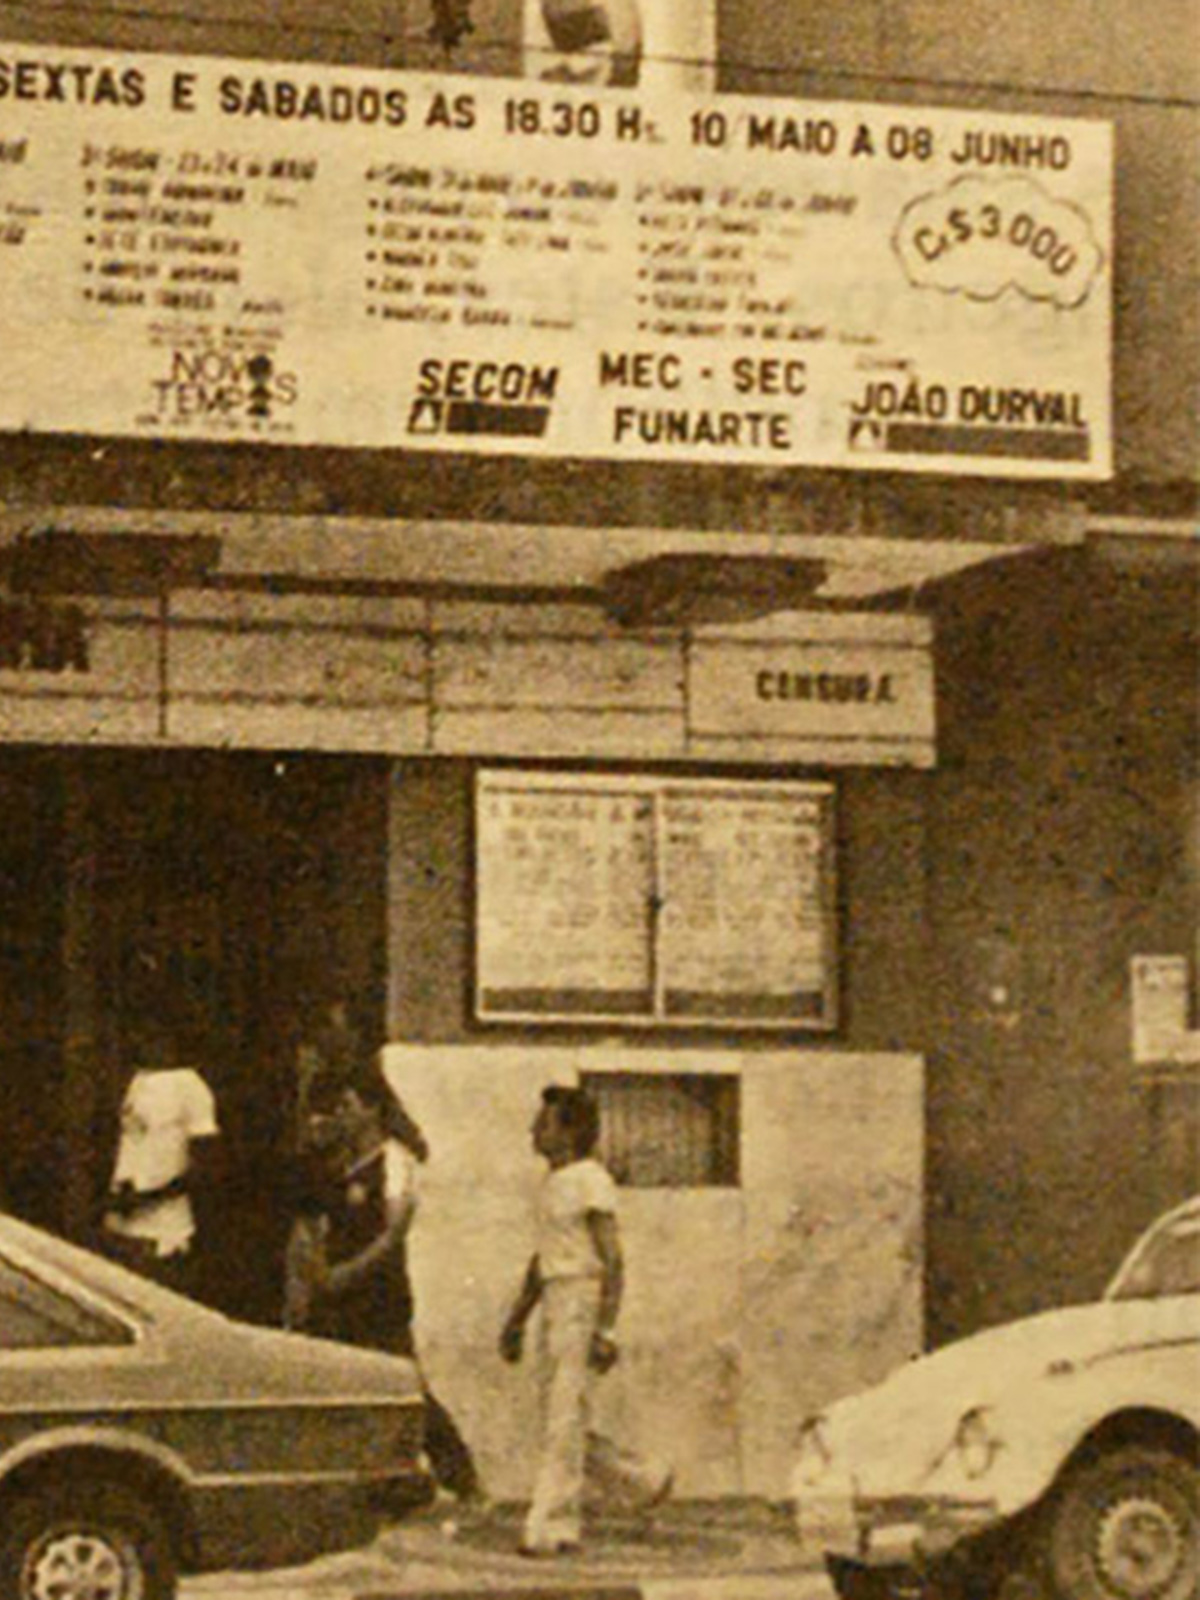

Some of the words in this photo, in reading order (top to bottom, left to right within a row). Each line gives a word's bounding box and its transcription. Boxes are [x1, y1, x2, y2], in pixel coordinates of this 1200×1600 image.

[172, 72, 196, 111] E
[219, 76, 408, 127] SABADOS
[425, 93, 477, 129] AS
[504, 98, 600, 138] 18.30
[690, 109, 727, 148] 10
[749, 114, 837, 155] MAIO
[851, 123, 874, 154] A
[886, 126, 933, 160] 08
[950, 130, 1071, 171] JUNHO
[416, 358, 560, 401] SECOM
[599, 351, 681, 390] MEC
[732, 356, 807, 397] SEC
[613, 405, 792, 450] FUNARTE
[958, 384, 1087, 428] DURVAL
